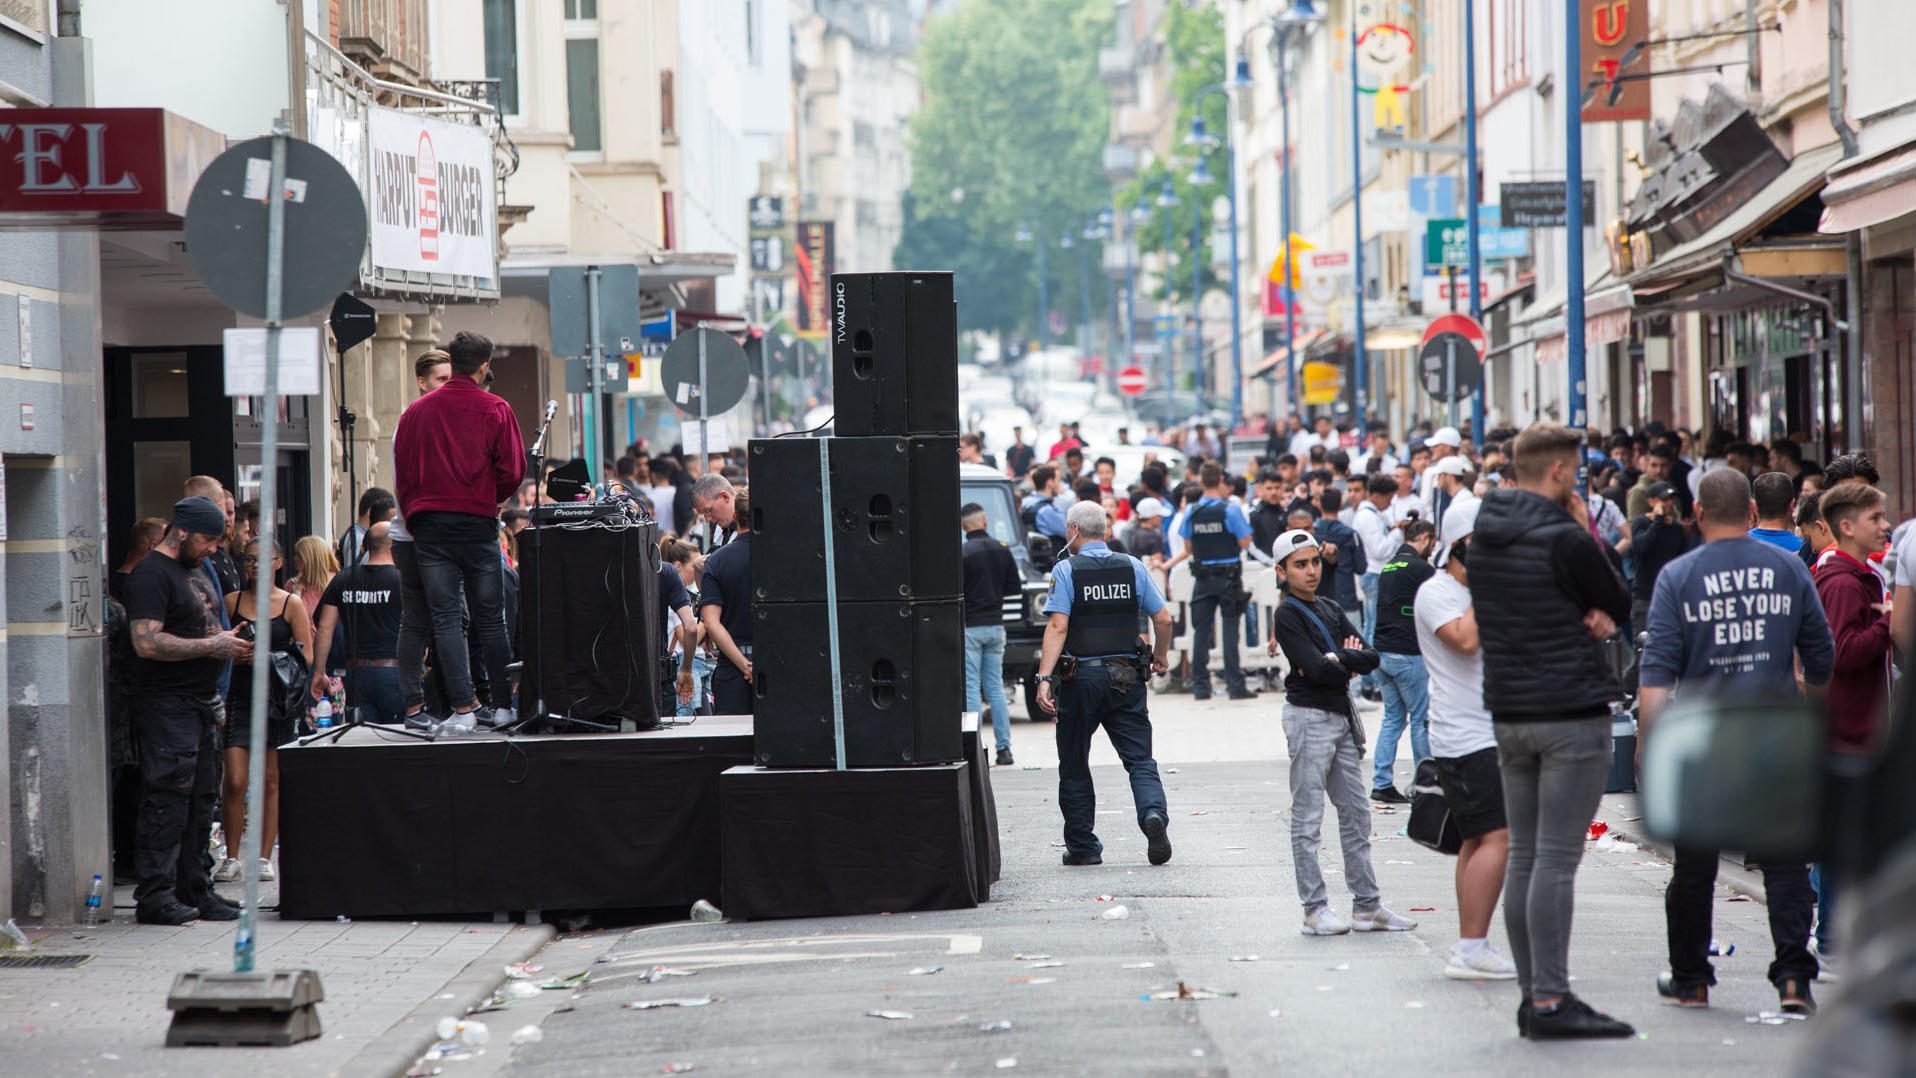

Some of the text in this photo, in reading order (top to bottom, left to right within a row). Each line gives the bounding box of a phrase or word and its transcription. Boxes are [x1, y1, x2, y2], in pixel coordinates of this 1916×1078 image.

[374, 148, 484, 237] HARPUT BURGER
[1193, 521, 1223, 534] POLIZEI
[1083, 583, 1131, 601] POLIZEI
[1703, 567, 1775, 597] NEVER
[1683, 592, 1792, 623] LOSE YOUR
[1714, 618, 1766, 645] EDGE
